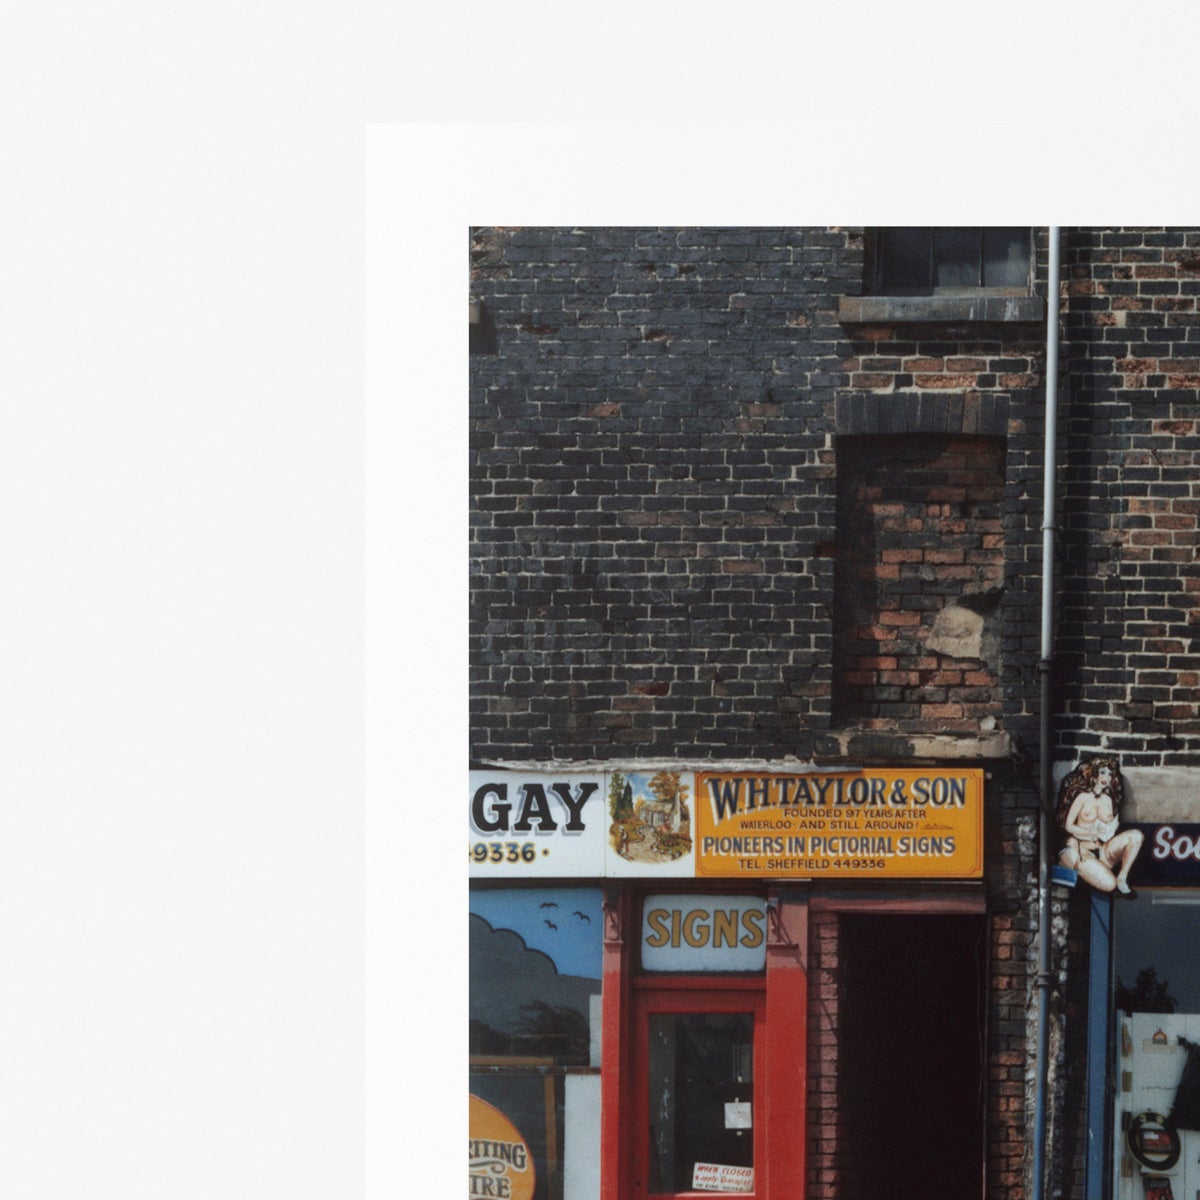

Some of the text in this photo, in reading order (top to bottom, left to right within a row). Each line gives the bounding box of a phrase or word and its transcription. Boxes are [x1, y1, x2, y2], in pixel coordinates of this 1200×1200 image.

[888, 778, 909, 809] &
[911, 776, 968, 809] SON
[469, 782, 599, 837] GAY
[783, 808, 927, 820] FOUNDED 97 YEARS AFTER
[799, 820, 827, 831] AND
[830, 820, 861, 831] STILL
[864, 820, 919, 831] AROUND!
[469, 841, 536, 865] 9336
[702, 835, 956, 857] PIONEERS IN PICTORIAL SIGNS
[767, 859, 830, 870] SHEFFIELD
[832, 859, 886, 869] 449336
[645, 908, 766, 949] SIGNS
[698, 1165, 752, 1177] WHEN CLOSED
